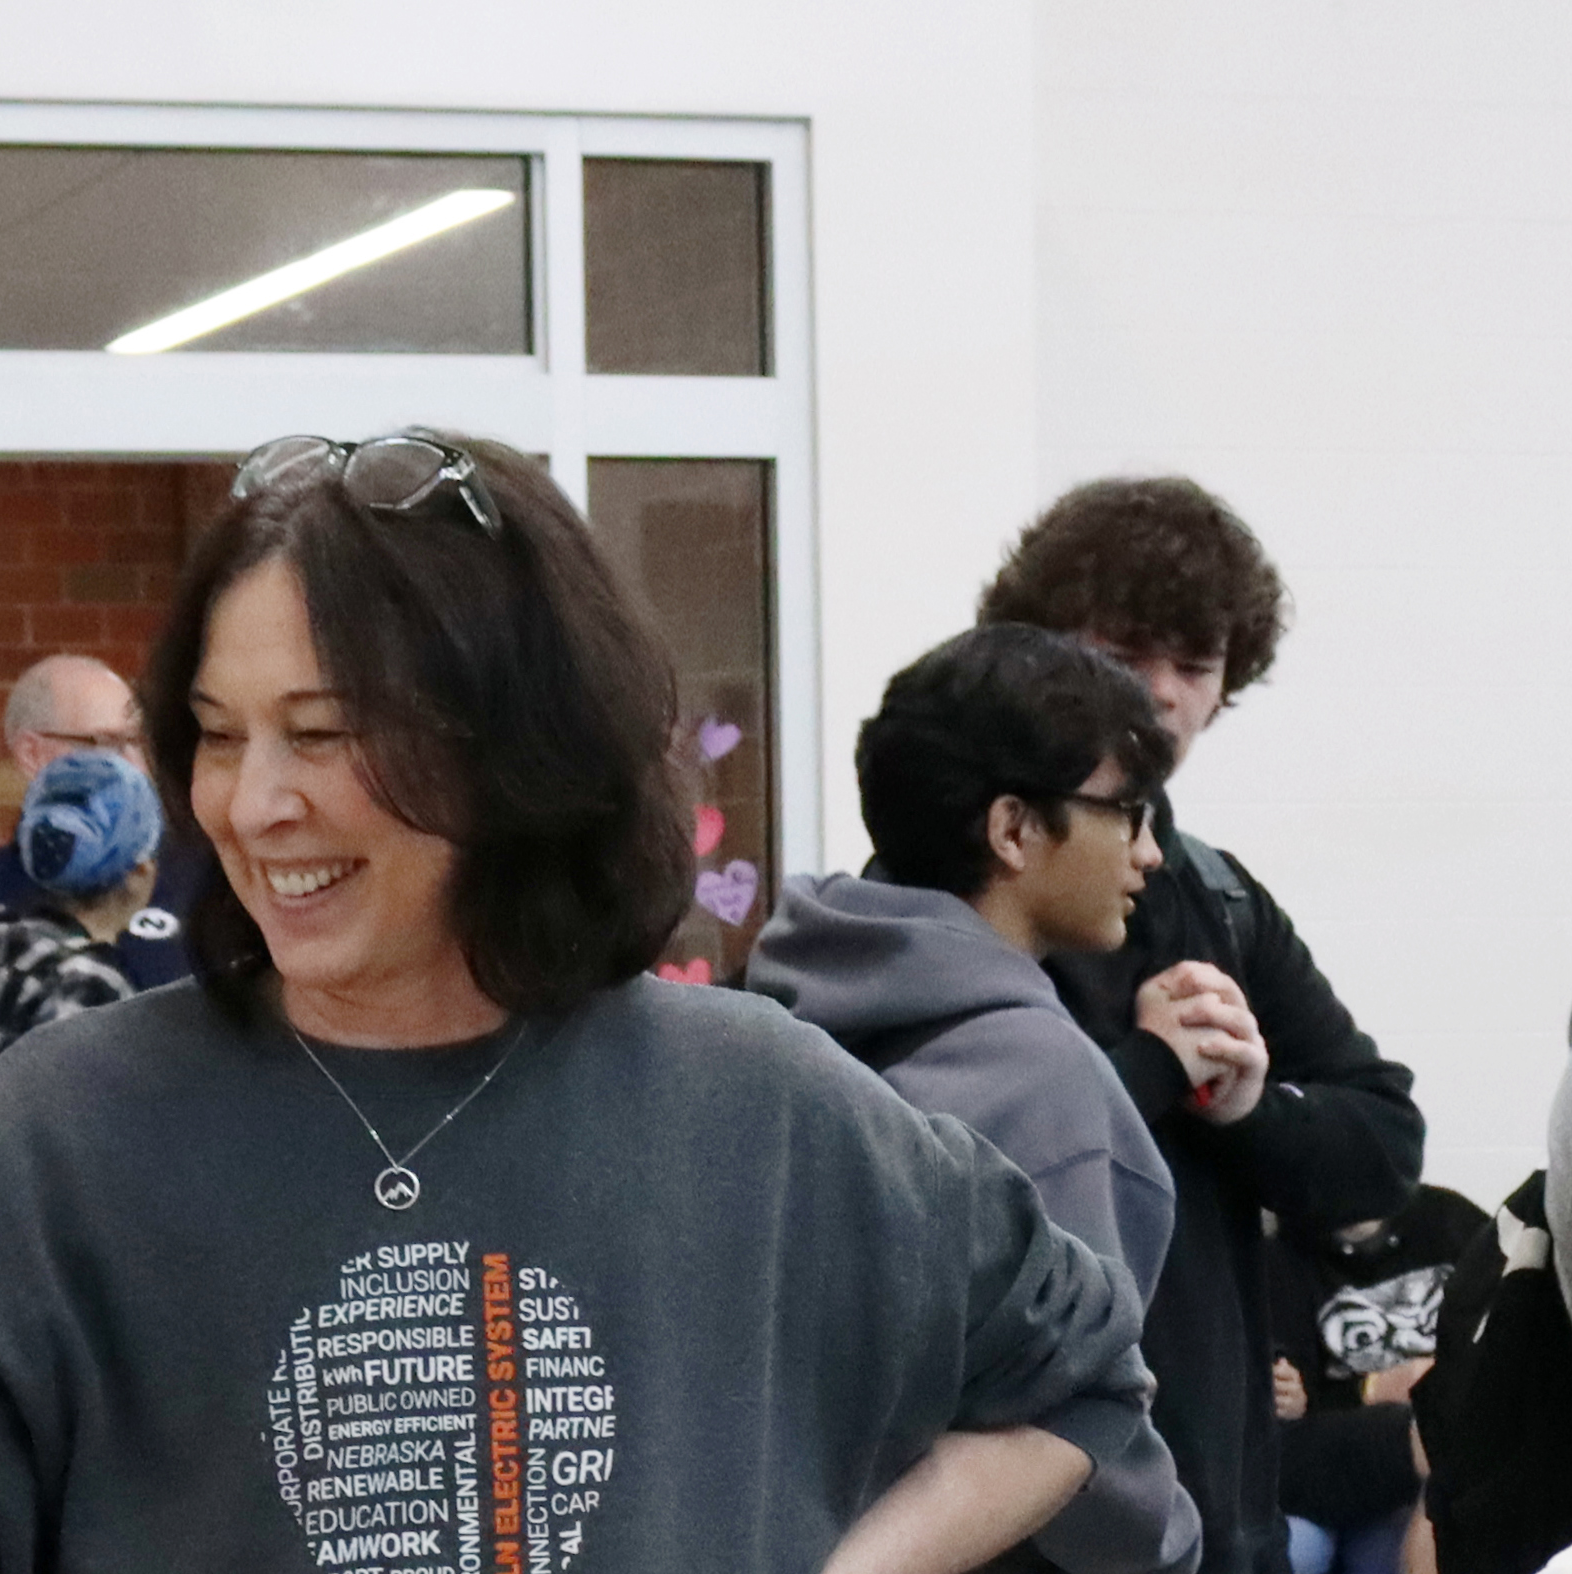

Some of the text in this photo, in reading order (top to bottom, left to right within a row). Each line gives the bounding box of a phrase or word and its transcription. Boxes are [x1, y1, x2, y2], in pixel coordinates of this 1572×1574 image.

[377, 1241, 470, 1269] SUPPLY
[340, 1268, 470, 1300] INCLUSION
[318, 1293, 466, 1328] EXPERIENCE
[482, 1253, 516, 1381] SYSTEM
[317, 1325, 475, 1359] RESPONSIBLE
[322, 1354, 475, 1387] kWh FUTURE
[526, 1356, 605, 1379] FINANC
[327, 1387, 476, 1417] PUBLIC OWNED
[329, 1414, 477, 1441] ENERGY EFFICIENT
[528, 1415, 617, 1441] PARTNE
[327, 1439, 446, 1471] NEBRASKA
[489, 1388, 521, 1535] ELECTRIC
[551, 1448, 614, 1486] GRI
[307, 1467, 445, 1502] RENEWABLE
[305, 1498, 449, 1536] EDUCATION
[551, 1490, 600, 1516] CAR
[307, 1529, 441, 1566] AMWORK
